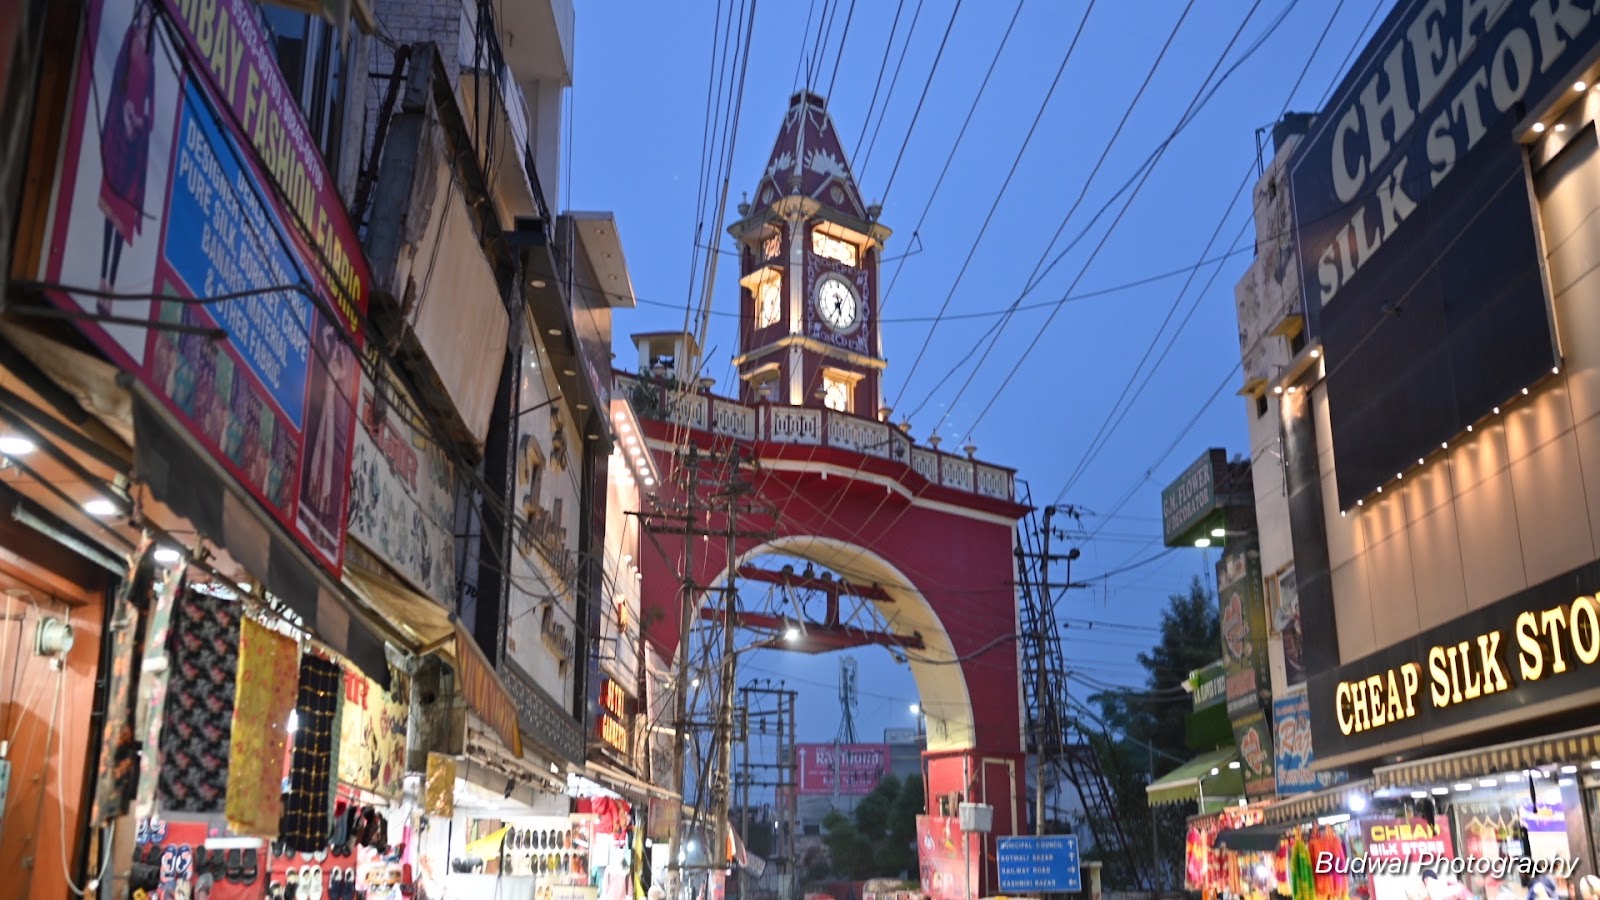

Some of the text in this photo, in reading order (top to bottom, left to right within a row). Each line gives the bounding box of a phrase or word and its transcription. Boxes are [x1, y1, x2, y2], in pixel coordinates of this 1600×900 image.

[187, 117, 240, 223] DESIGNER
[1318, 0, 1600, 307] SILK STOR
[242, 61, 315, 244] FASHION
[315, 204, 360, 332] FABRIC
[180, 147, 212, 216] PURE
[213, 200, 237, 262] SILK,
[282, 308, 307, 362] CRAPE
[202, 222, 287, 368] BANARSI MATERIAL
[205, 268, 281, 390] & OTHER FABRIC
[1171, 487, 1209, 530] DECORATOR
[1179, 464, 1210, 506] FLOWER
[1336, 662, 1420, 736] CHEAP
[1428, 630, 1508, 708] SILK
[1516, 591, 1600, 681] STO
[1001, 841, 1063, 850] MUNICIPAL COUNCIL
[1001, 854, 1030, 862] KOTWALI
[1370, 843, 1398, 857] SILK
[1371, 824, 1441, 842] CHEAP
[1001, 866, 1051, 875] RAILWAY ROAD
